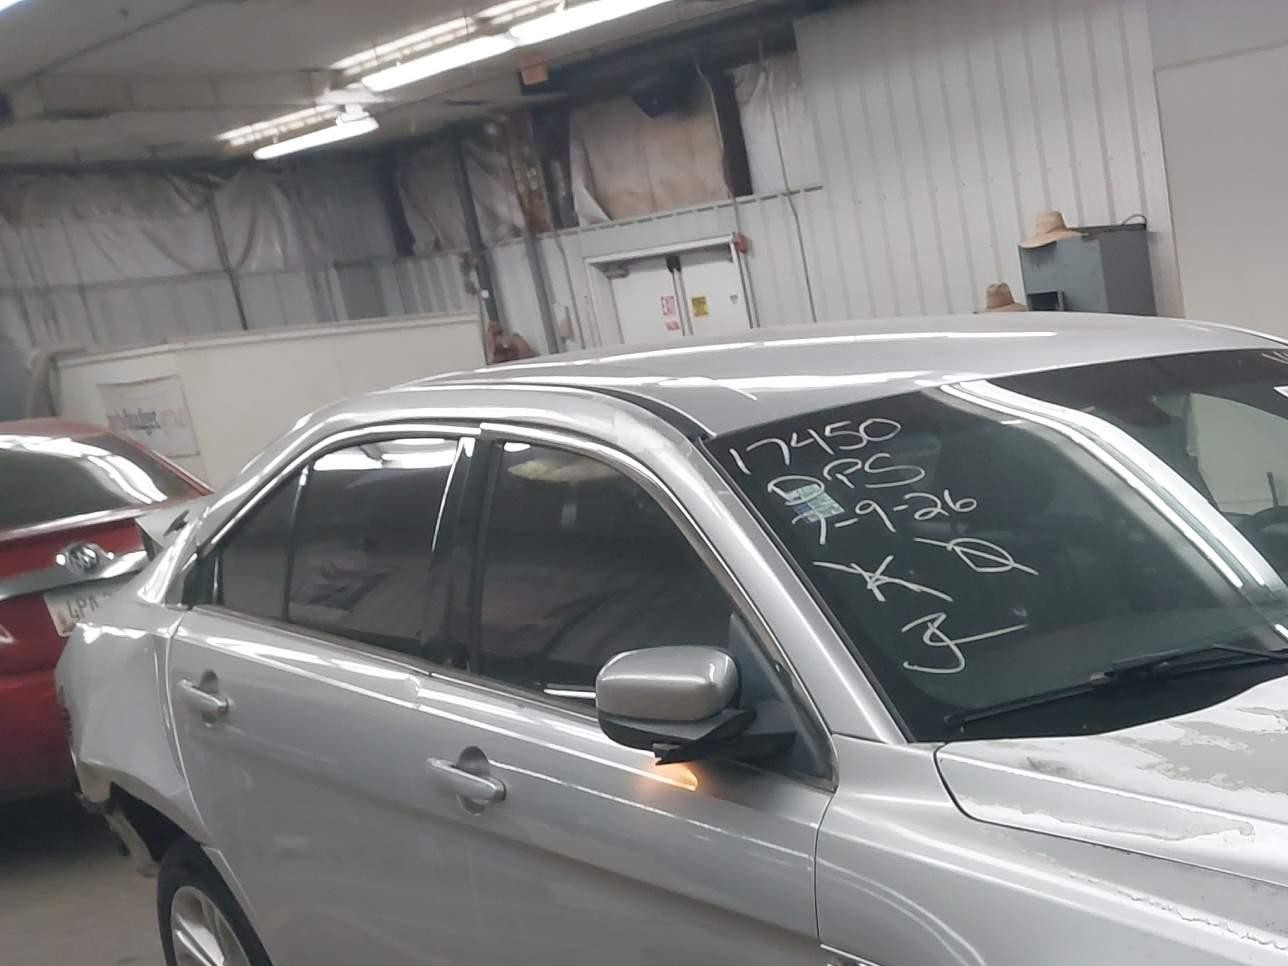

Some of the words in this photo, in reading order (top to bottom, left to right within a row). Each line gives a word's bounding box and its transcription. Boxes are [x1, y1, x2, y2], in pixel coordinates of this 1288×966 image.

[728, 417, 901, 476] 17450
[766, 452, 926, 506] DPS
[791, 488, 978, 546] 7-9-26
